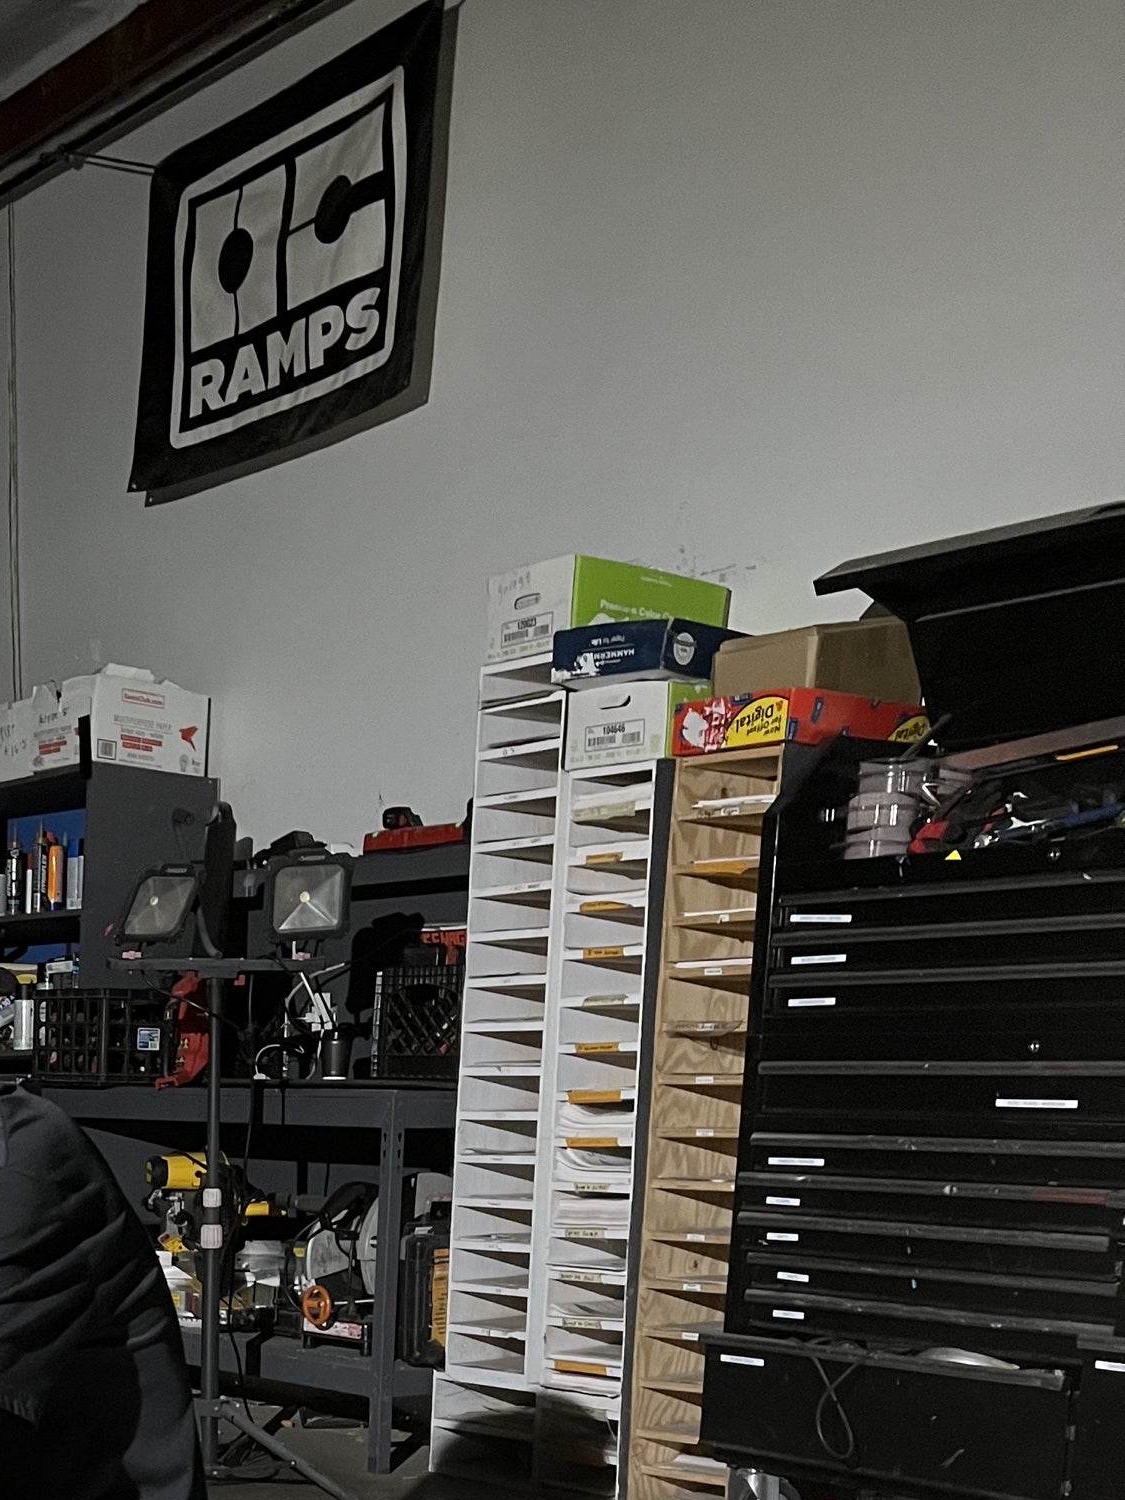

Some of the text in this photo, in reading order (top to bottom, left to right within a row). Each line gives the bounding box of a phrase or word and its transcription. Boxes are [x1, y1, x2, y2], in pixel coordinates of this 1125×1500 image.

[189, 286, 382, 420] RAMPS
[638, 607, 662, 619] Color
[736, 703, 775, 734] Digital
